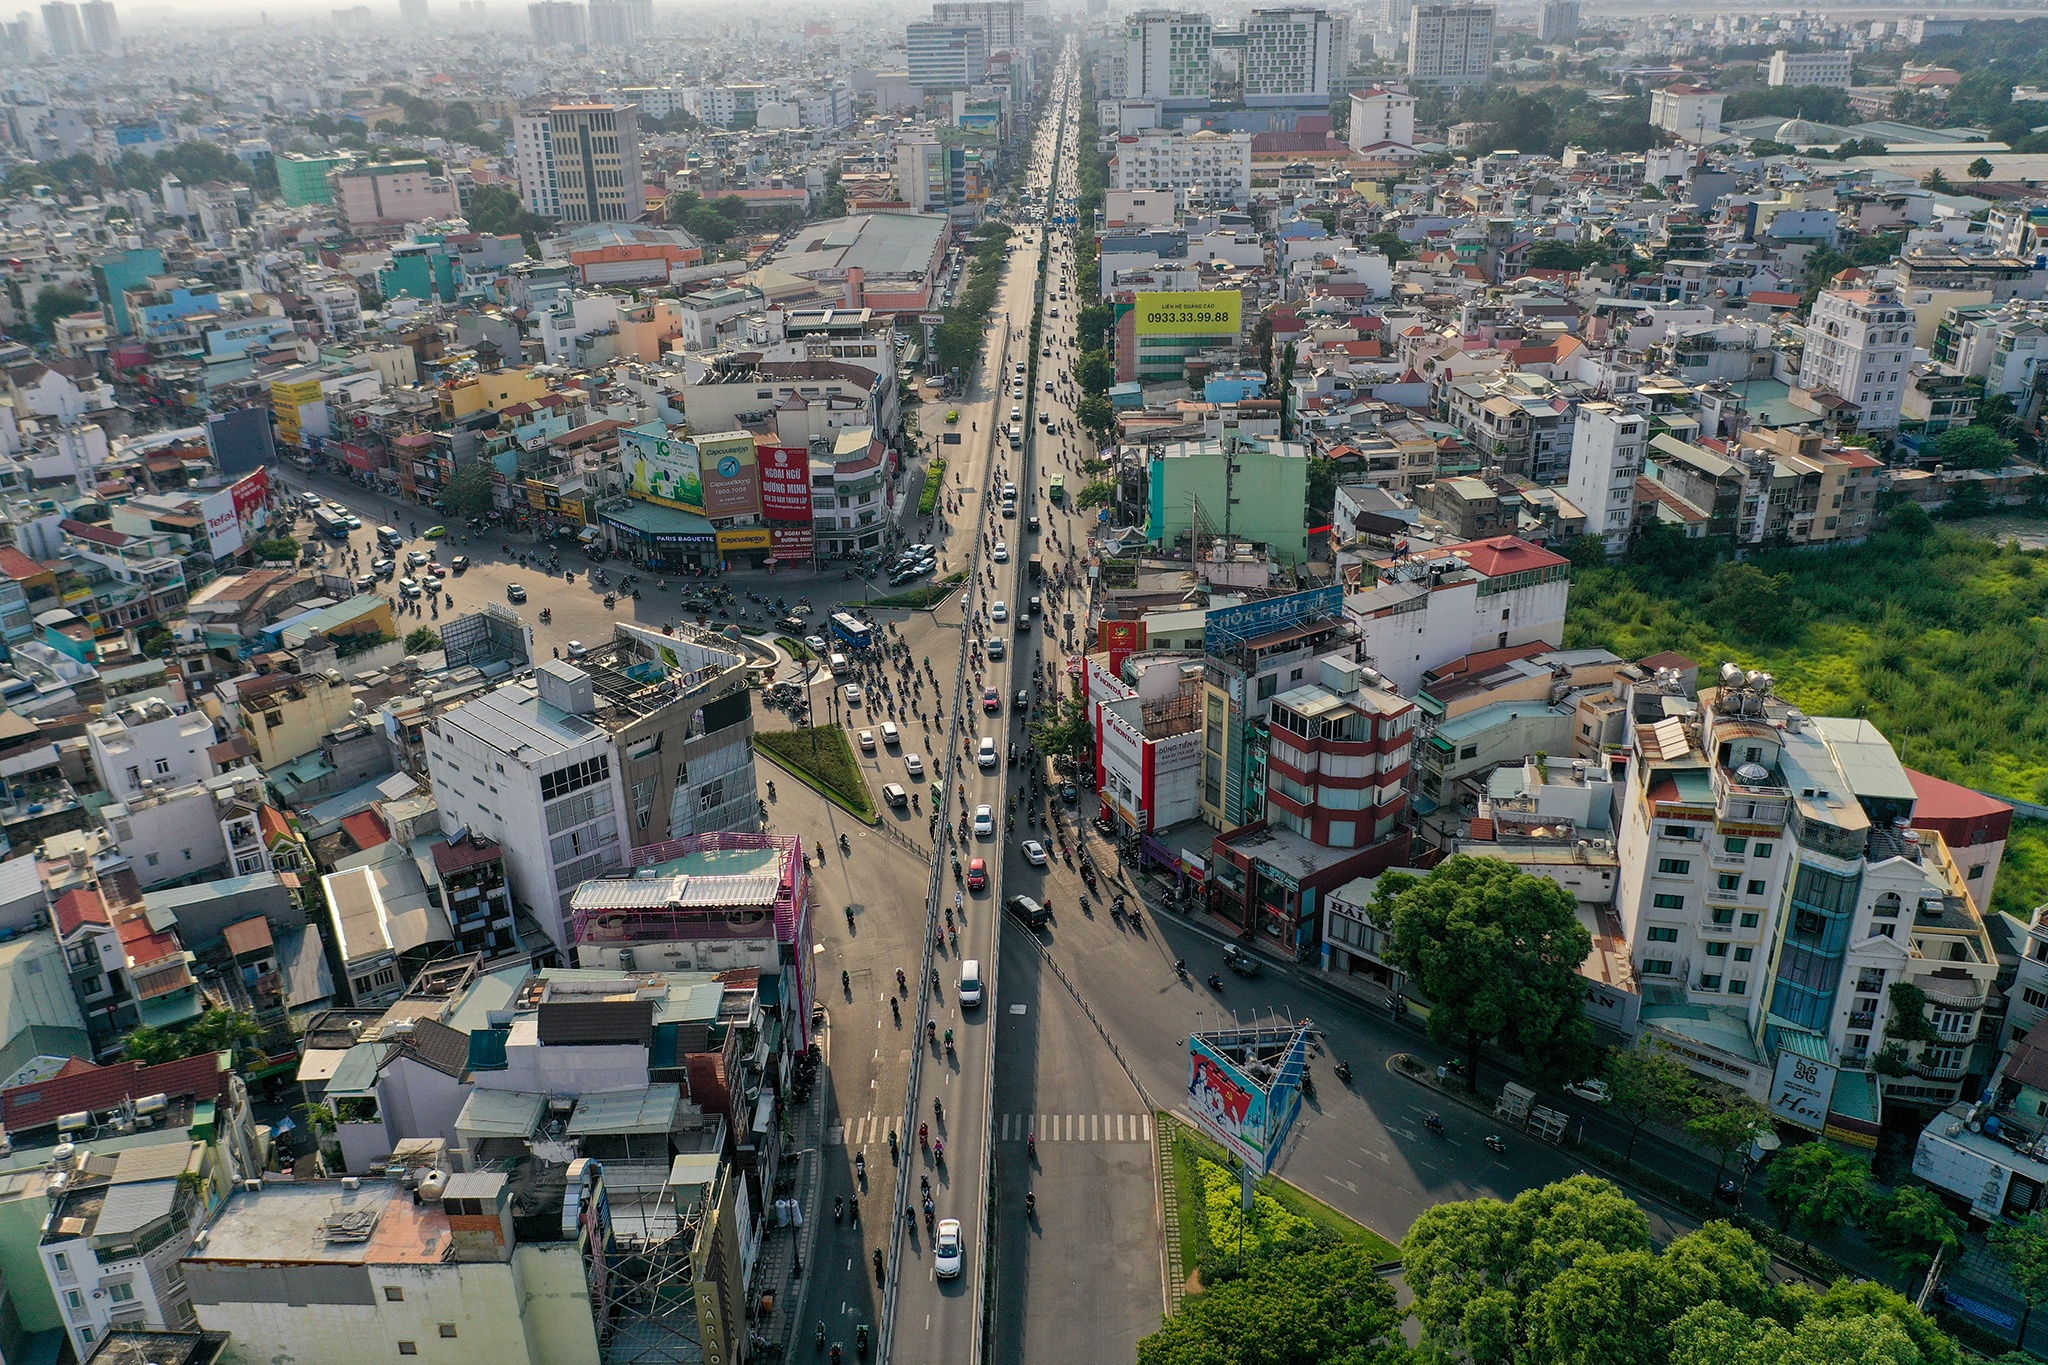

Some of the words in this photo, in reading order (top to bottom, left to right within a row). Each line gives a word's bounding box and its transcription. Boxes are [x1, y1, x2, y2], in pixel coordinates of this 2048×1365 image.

[1147, 312, 1229, 323] 0933.33.99.88
[764, 468, 784, 480] NGOẠI
[763, 481, 785, 493] DƯƠNG
[787, 484, 806, 494] MINH
[208, 510, 235, 528] Tefal
[721, 535, 766, 544] Capcuulaptop
[1219, 608, 1254, 628] HÒA
[1260, 599, 1300, 620] PHÁT
[672, 664, 720, 690] HOTEL
[1099, 676, 1122, 698] HONDA
[1112, 723, 1137, 748] HONDA
[1688, 813, 1713, 821] SAIGON
[1754, 830, 1781, 838] SAIGON
